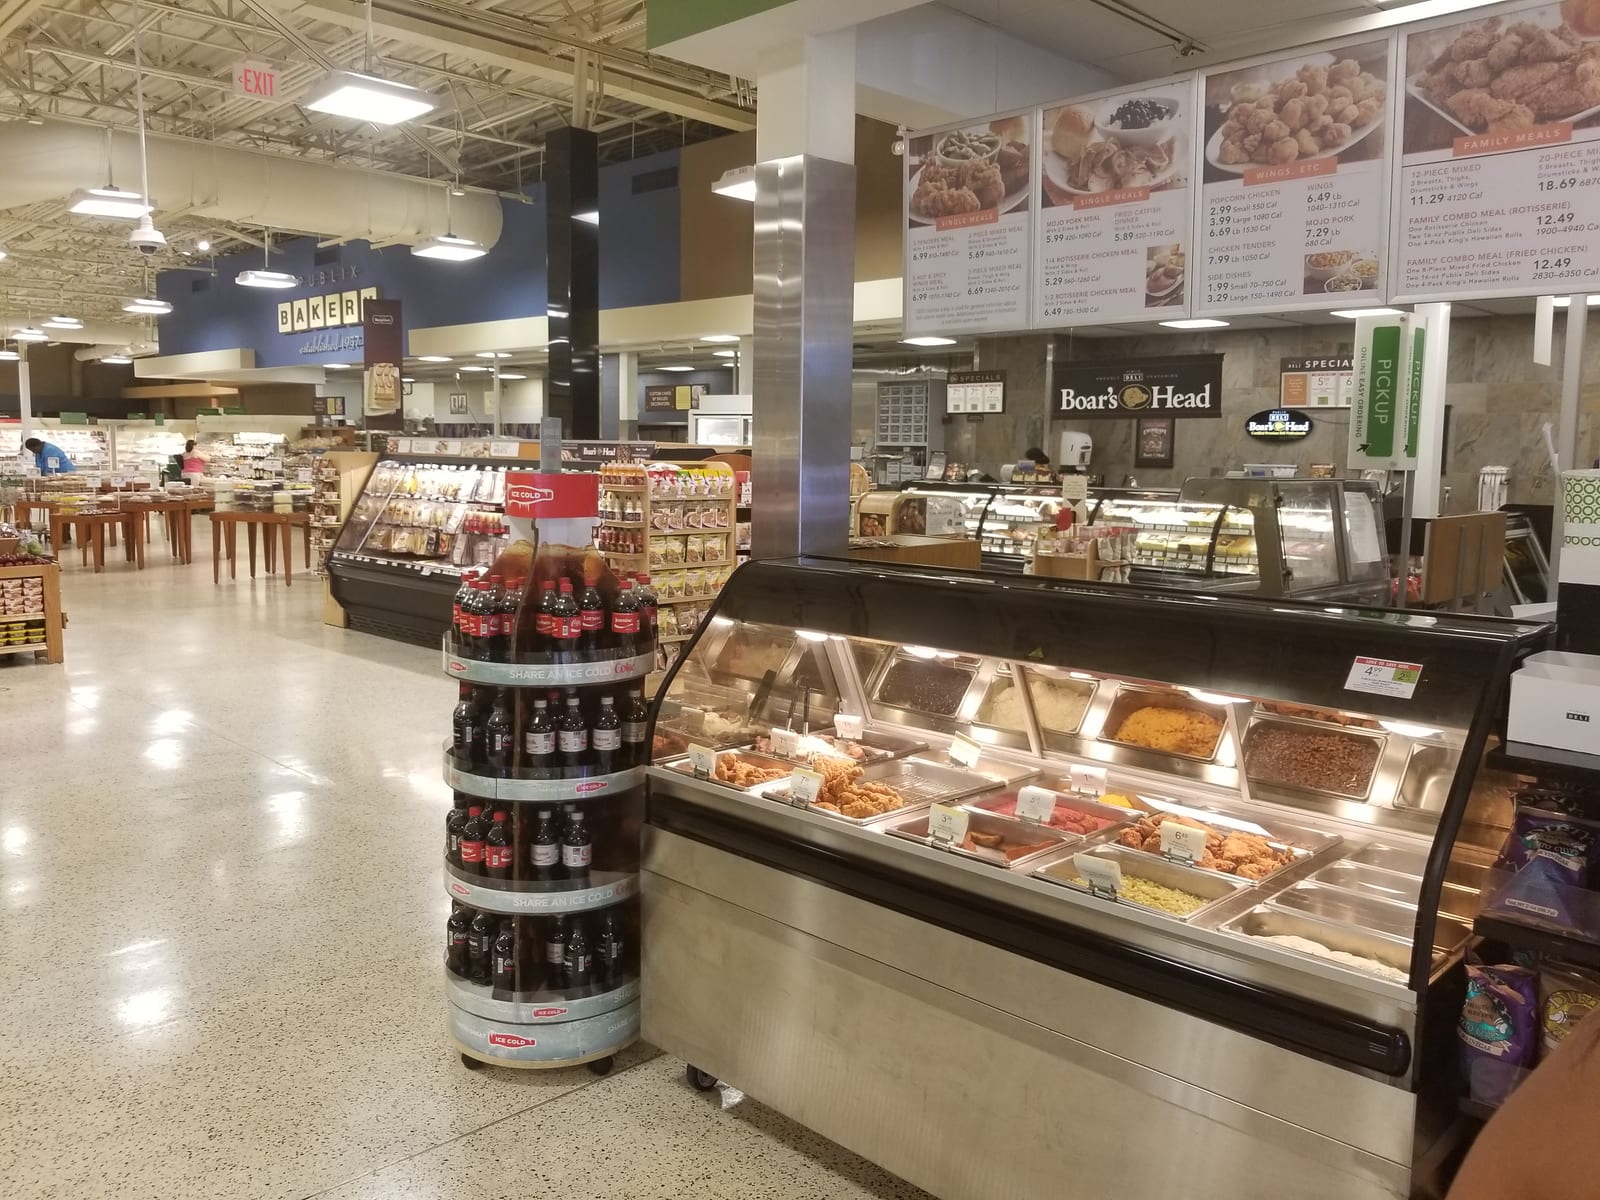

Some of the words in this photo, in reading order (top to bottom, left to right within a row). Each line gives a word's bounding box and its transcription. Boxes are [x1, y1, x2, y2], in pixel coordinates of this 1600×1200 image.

[243, 68, 274, 97] EXIT
[1464, 136, 1509, 149] FAMILY
[1516, 128, 1560, 142] MEALS
[1538, 149, 1585, 163] 20-PIECE
[1412, 167, 1448, 178] 12-PIECE
[1452, 163, 1481, 174] MIXED
[1307, 182, 1334, 191] WINGS
[1458, 182, 1478, 190] Wings
[1538, 178, 1576, 192] 18.69
[1080, 196, 1109, 206] SINGLE
[1211, 194, 1245, 204] POPCORN
[1248, 189, 1280, 199] CHICKEN
[1307, 192, 1330, 203] 6.49
[1411, 193, 1444, 206] 11.29
[1447, 193, 1467, 202] 4120
[1211, 206, 1231, 215] 2.99
[1233, 204, 1250, 213] Small
[1252, 202, 1265, 210] 550
[1409, 215, 1440, 225] FAMILY
[1442, 211, 1478, 222] COMBO
[1480, 209, 1506, 217] MEAL
[1509, 202, 1571, 216] (ROTISSERIE)
[970, 214, 993, 223] MEALS
[1210, 216, 1231, 226] 3.99
[1233, 216, 1251, 225] Large
[1306, 218, 1329, 226] MOJO
[1333, 215, 1354, 223] PORK
[1460, 219, 1488, 227] Chicken
[1536, 213, 1574, 225] 12.49
[1210, 227, 1230, 237] 6.69
[1243, 225, 1258, 233] 1530
[1306, 228, 1329, 238] 7.29
[1046, 234, 1064, 243] 5.99
[1115, 232, 1133, 241] 5.89
[1471, 233, 1502, 241] Hawaiian
[1209, 244, 1241, 254] CHICKEN
[1243, 241, 1276, 249] TENDERS
[913, 252, 928, 261] 6.99
[968, 250, 984, 259] 5.69
[1057, 254, 1089, 263] ROTISSERIE
[1091, 251, 1119, 259] CHICKEN
[1407, 257, 1438, 266] FAMILY
[1440, 253, 1475, 263] COMBO
[1478, 250, 1503, 259] MEAL
[1506, 247, 1537, 259] (FRIED
[1540, 245, 1588, 256] CHICKEN)
[1208, 255, 1230, 265] 7.99
[1472, 261, 1490, 269] Fried
[1534, 258, 1571, 269] 12.49
[297, 265, 358, 287] PUBLIX
[1226, 271, 1251, 280] DISHES
[1584, 267, 1599, 277] Cal
[1045, 277, 1063, 286] 5.29
[1469, 276, 1500, 284] Hawaiian
[968, 287, 983, 295] 6.69
[1208, 282, 1228, 292] 1.99
[913, 293, 927, 302] 6.99
[1056, 291, 1089, 299] ROTISSERIE
[1208, 293, 1228, 303] 3.29
[1230, 294, 1249, 302] Large
[280, 294, 374, 326] BAKER
[1044, 308, 1061, 317] 6.49
[1061, 386, 1118, 410] Boar's
[1151, 383, 1211, 409] Head
[1374, 359, 1391, 424] PICKUP
[1411, 360, 1421, 424] PICKUP
[1355, 399, 1364, 438] ORDERING
[1285, 421, 1309, 431] Head
[520, 491, 541, 499] COLD
[509, 670, 545, 679] SHARE
[547, 670, 562, 679] AN
[566, 669, 583, 678] ICE
[585, 666, 612, 677] COLD
[513, 898, 549, 907] SHARE
[551, 897, 567, 907] AN
[569, 895, 586, 905] ICE
[587, 889, 613, 902] COLD
[506, 1038, 526, 1046] COLD
